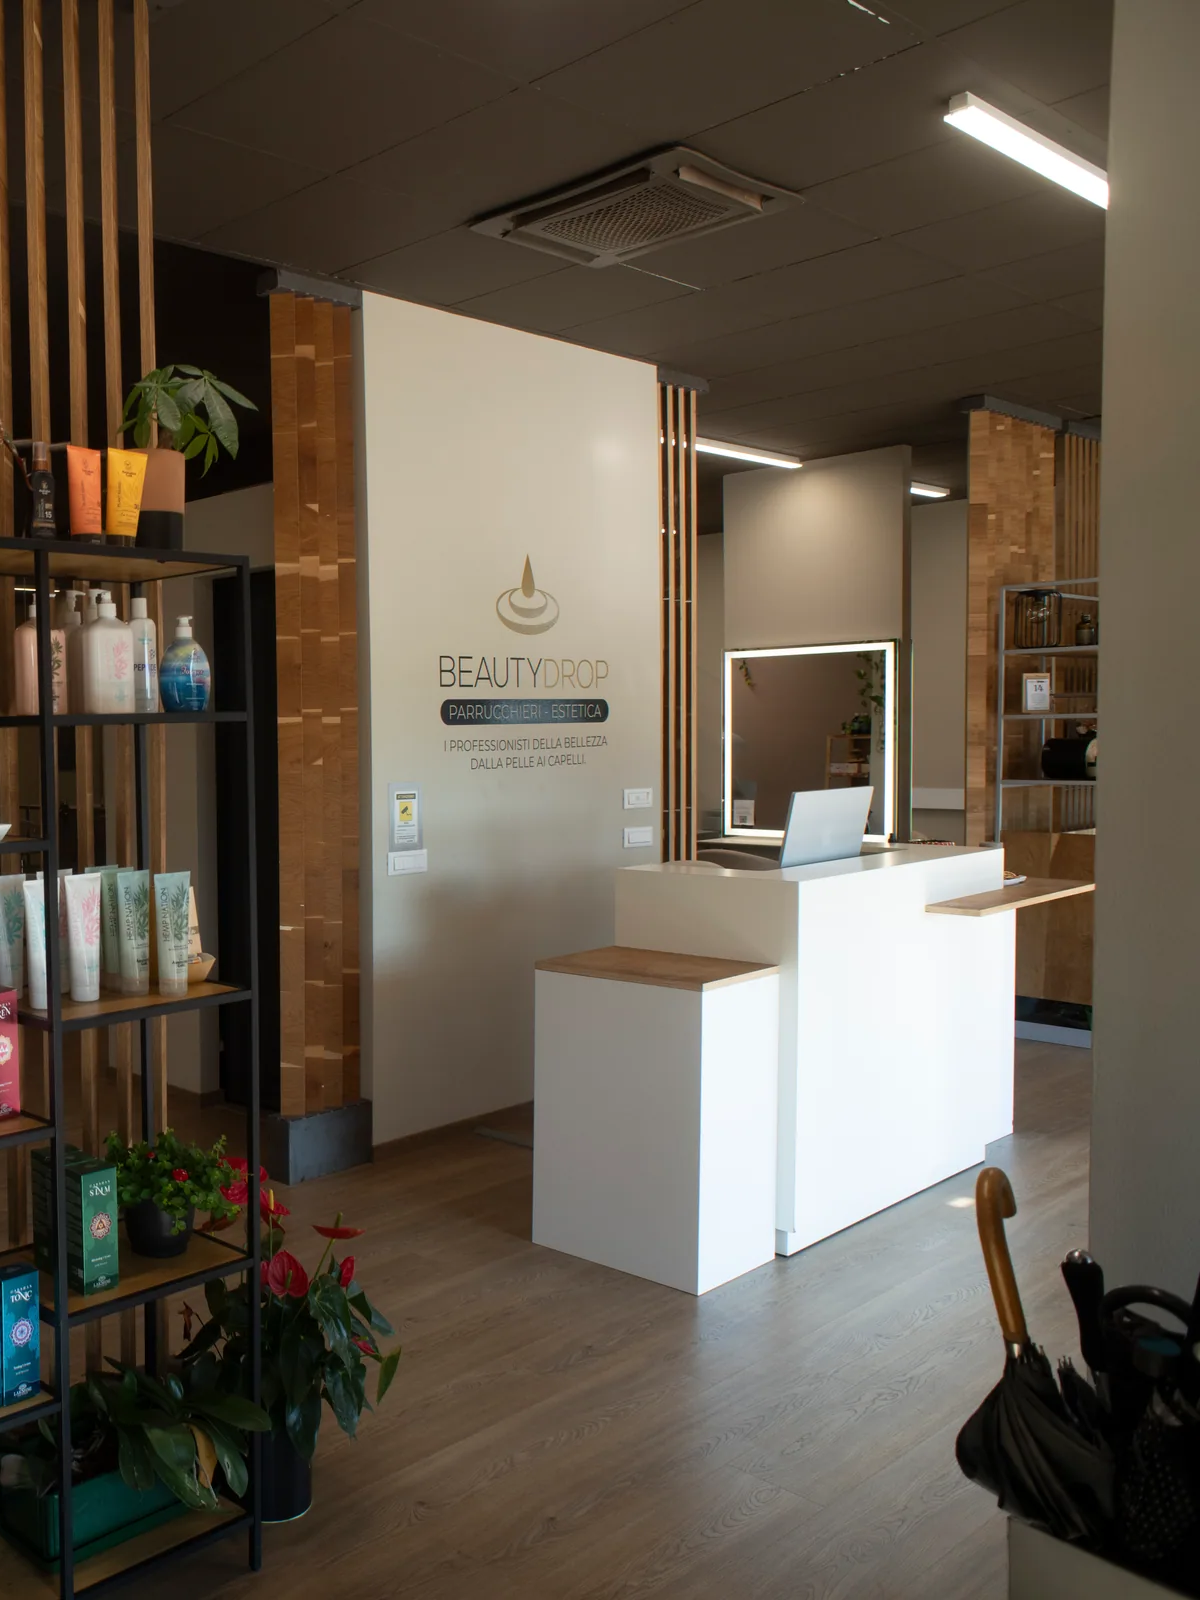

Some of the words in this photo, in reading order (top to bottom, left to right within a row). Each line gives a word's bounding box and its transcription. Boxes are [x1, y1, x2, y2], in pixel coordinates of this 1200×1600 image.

[438, 655, 610, 689] BEAUTYDROP
[449, 704, 541, 720] PARRUCCHIERI
[551, 703, 602, 719] ESTETICA
[450, 738, 530, 752] PROFESSIONISTI
[533, 737, 563, 750] DELLA
[564, 735, 608, 749] BELLEZZA
[470, 757, 504, 770] DALLA
[505, 756, 535, 769] PELLE
[536, 755, 546, 768] AI
[124, 886, 133, 918] NATION
[160, 887, 169, 920] NATION
[125, 918, 133, 941] HEMP
[162, 921, 170, 942] HEMP
[10, 1289, 33, 1303] TONIC
